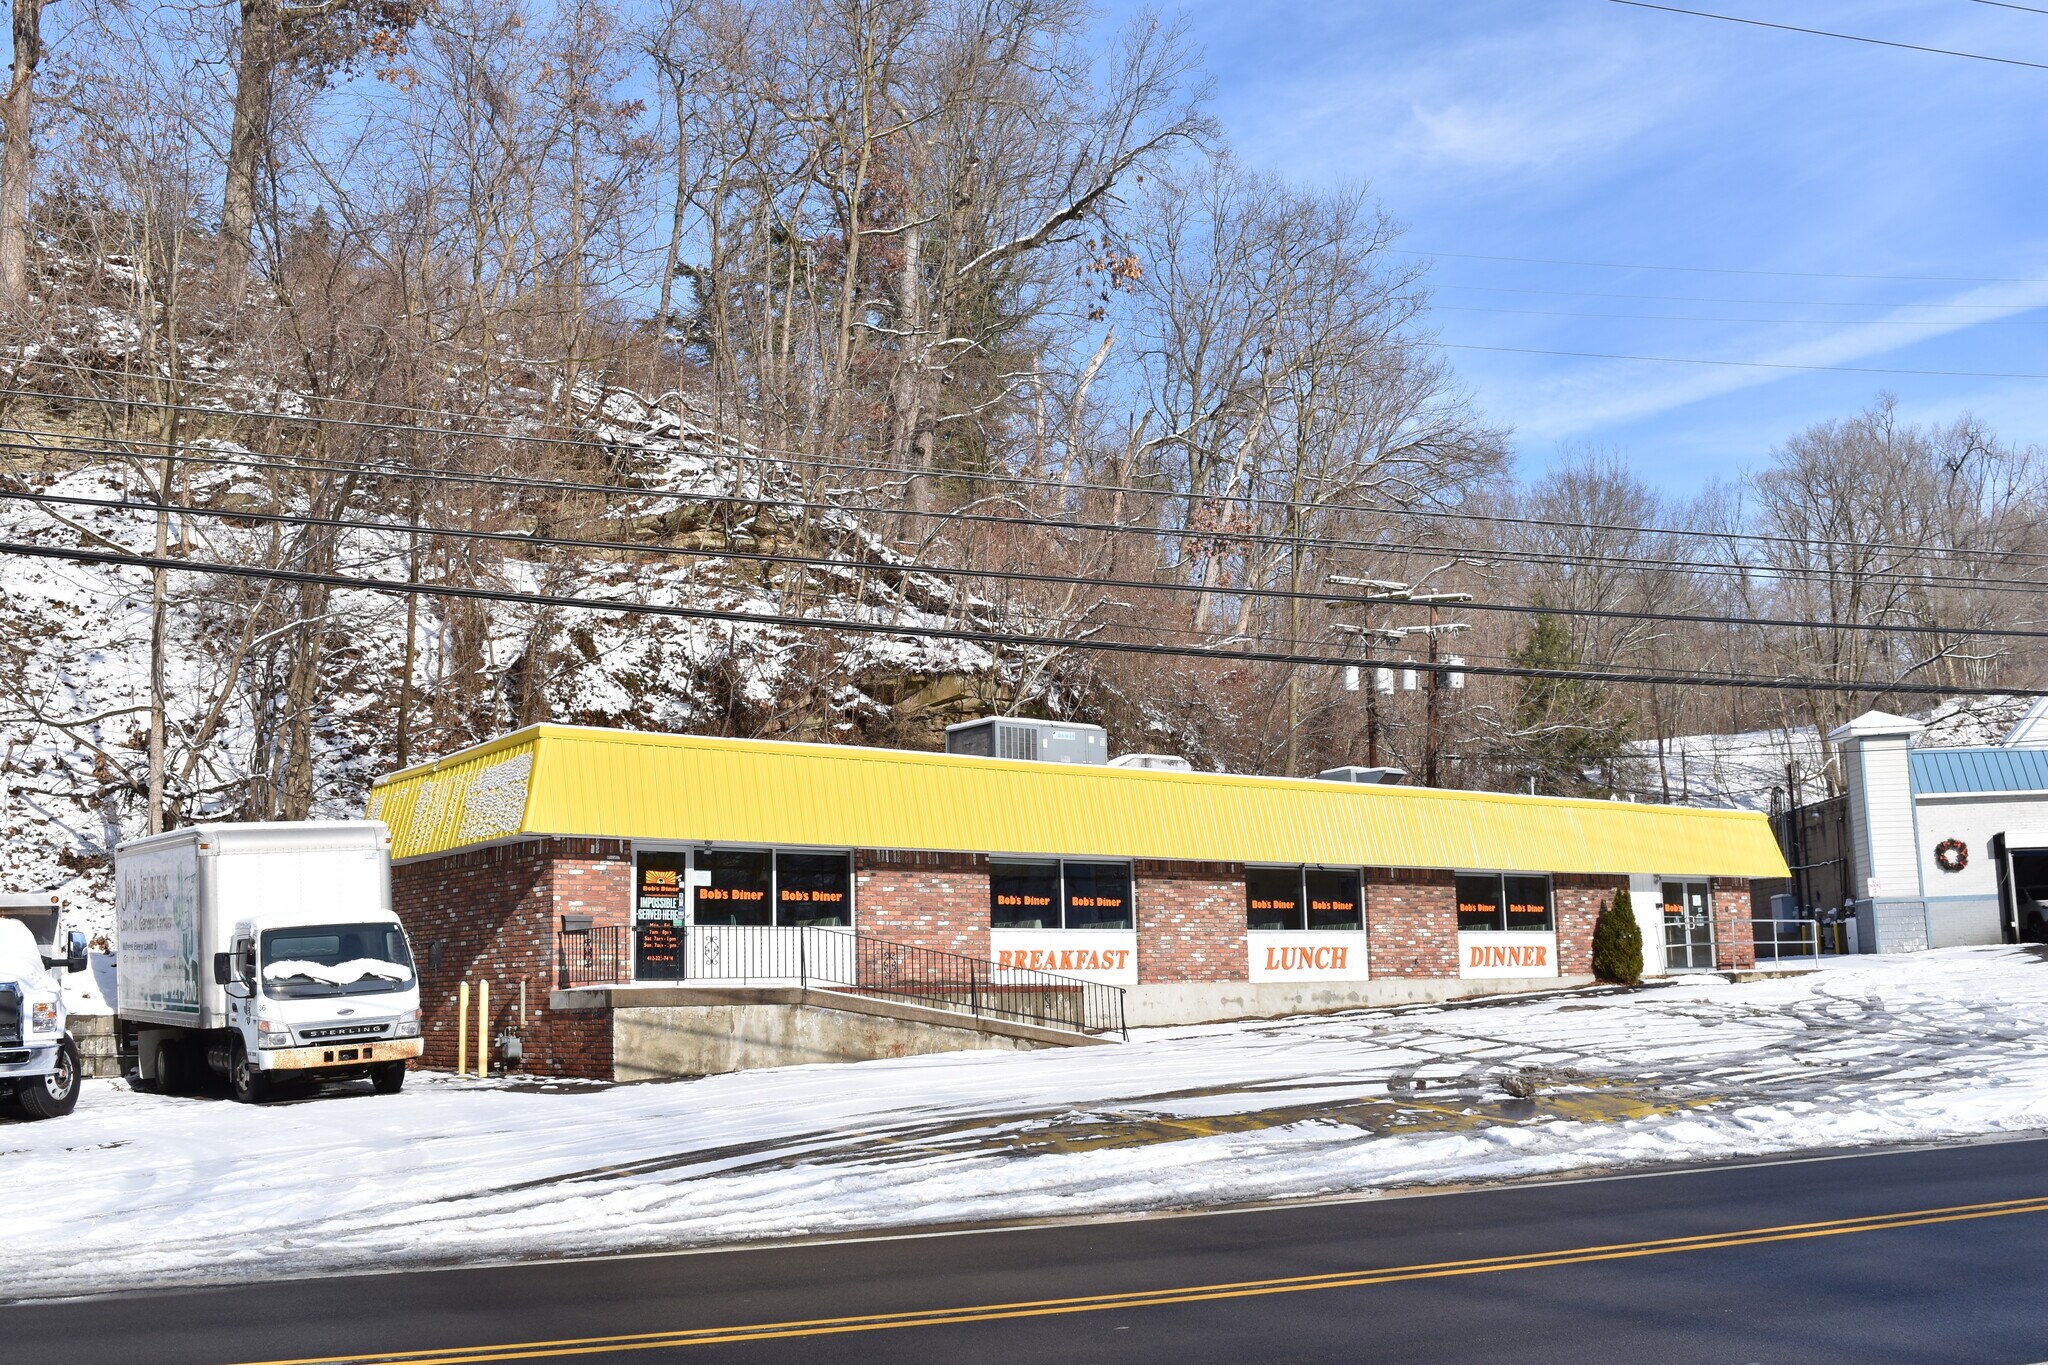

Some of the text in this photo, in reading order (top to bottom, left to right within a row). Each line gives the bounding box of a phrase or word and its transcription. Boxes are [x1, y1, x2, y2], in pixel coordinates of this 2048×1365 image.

[699, 888, 764, 901] Bob's Diner
[781, 890, 843, 902] Bob's Diner
[997, 895, 1050, 906] Bob's Diner
[1072, 896, 1122, 907] Bob's Diner
[1252, 900, 1295, 909] Bob's Diner
[1312, 901, 1354, 910] Bob's Diner
[1459, 904, 1496, 912] Bob's Diner
[1510, 904, 1545, 913] Bob's Diner
[1664, 904, 1683, 913] Bob's
[996, 950, 1129, 970] BREAKFAST
[1265, 947, 1348, 970] LUNCH
[1469, 946, 1547, 967] DINNER
[310, 1025, 381, 1037] STERLING
